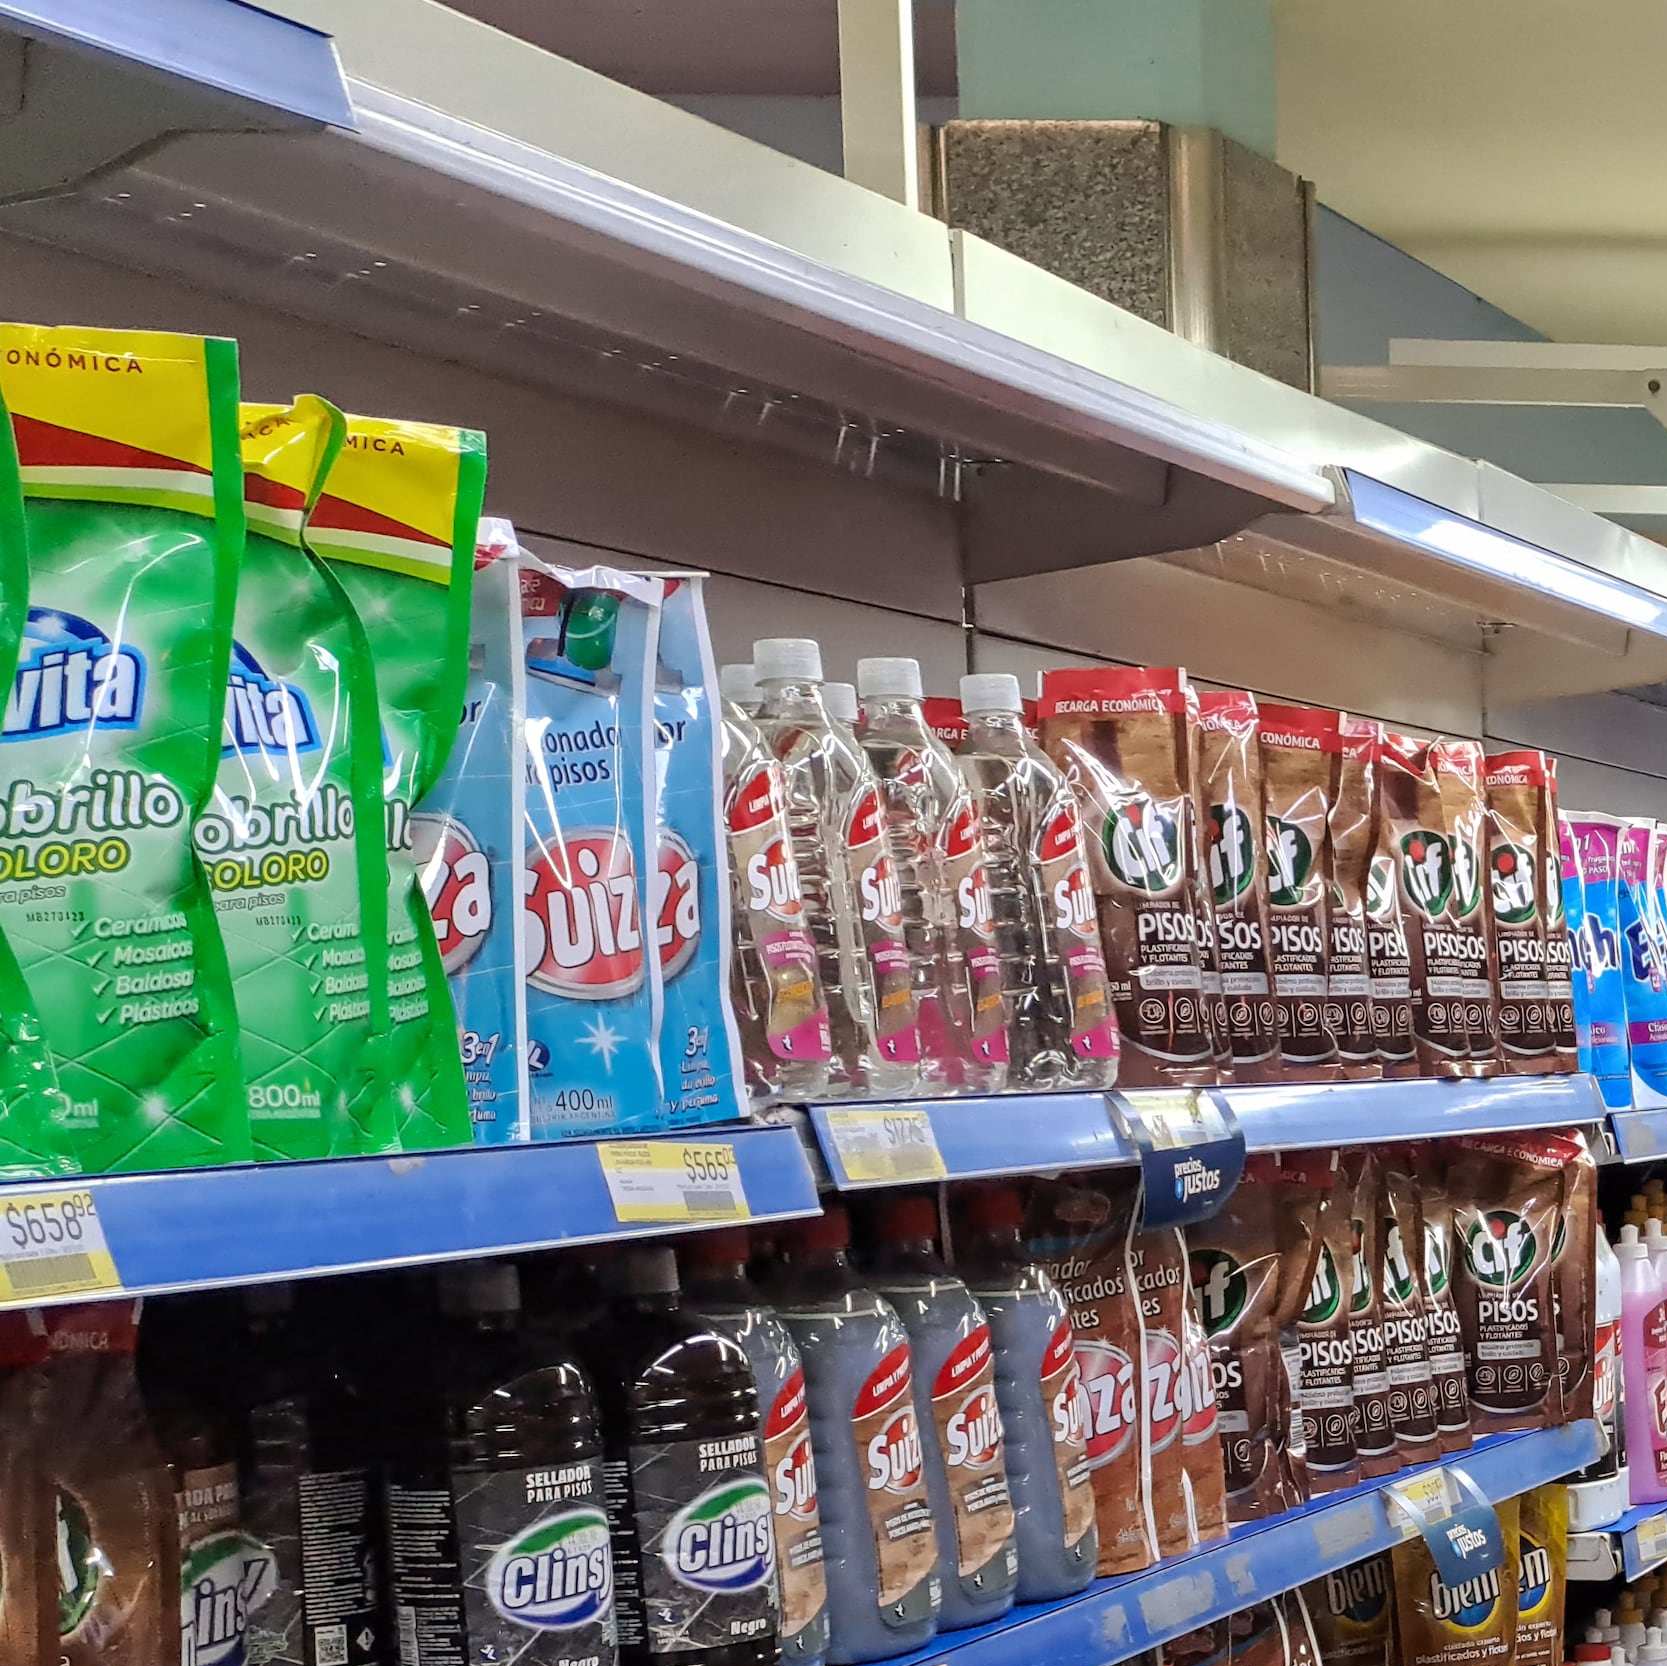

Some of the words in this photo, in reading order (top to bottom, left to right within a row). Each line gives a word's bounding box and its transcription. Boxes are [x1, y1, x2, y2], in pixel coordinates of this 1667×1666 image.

[6, 349, 144, 374] ONÓMICA
[1054, 699, 1099, 714] RECARGA
[1102, 697, 1166, 714] ECONÓMICA
[1260, 731, 1320, 749] CONÓMICA
[551, 757, 610, 787] pisos
[94, 908, 188, 938] Cerámicos
[1138, 912, 1194, 941] PISOS
[1271, 928, 1322, 953] PISOS
[1500, 938, 1544, 960] PISOS
[113, 940, 194, 966] Mosaicos
[249, 1083, 321, 1109] 800ml
[555, 1088, 614, 1113] 400ml
[1507, 1146, 1563, 1167] ECONÓMICA
[1182, 1166, 1220, 1197] justos
[1479, 1299, 1539, 1322] PISOS
[1385, 1319, 1425, 1343] PISOS
[698, 1437, 757, 1460] SELLADOR
[700, 1454, 730, 1473] PARA
[730, 1450, 758, 1471] PISOS
[526, 1465, 592, 1490] SELLADOR
[527, 1485, 559, 1503] PARA
[560, 1479, 593, 1500] PISOS
[1461, 1530, 1486, 1551] justos
[730, 1617, 767, 1637] Negro
[1416, 1649, 1478, 1665] plastificados
